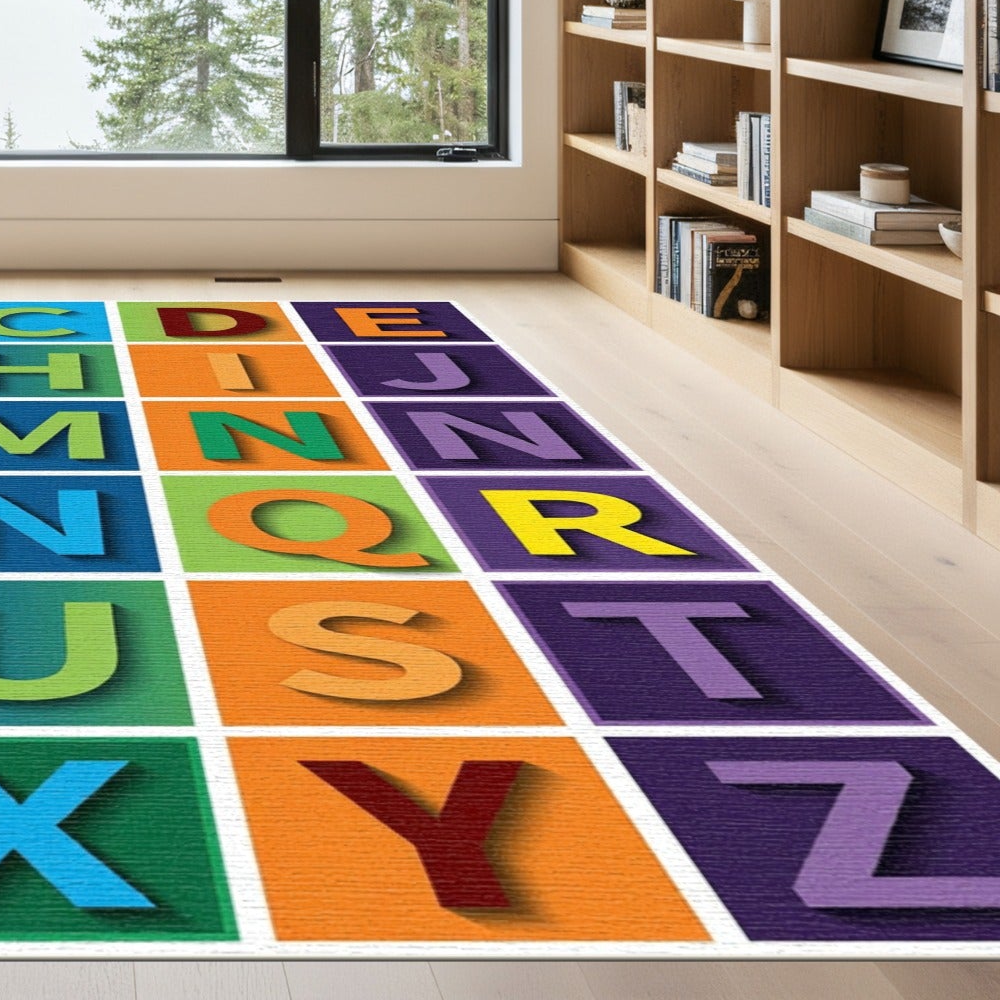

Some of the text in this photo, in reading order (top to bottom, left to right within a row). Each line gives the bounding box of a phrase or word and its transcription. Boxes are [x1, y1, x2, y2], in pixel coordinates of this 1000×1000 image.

[157, 307, 266, 337] D
[334, 307, 448, 337] E
[206, 352, 254, 390] I
[380, 352, 470, 390] J
[189, 411, 344, 460] N
[406, 411, 583, 460] N
[207, 489, 430, 568] Q
[480, 490, 698, 556] R
[267, 601, 462, 701] S
[561, 602, 763, 699] T
[296, 760, 524, 908] Y
[705, 760, 1000, 908] Z
